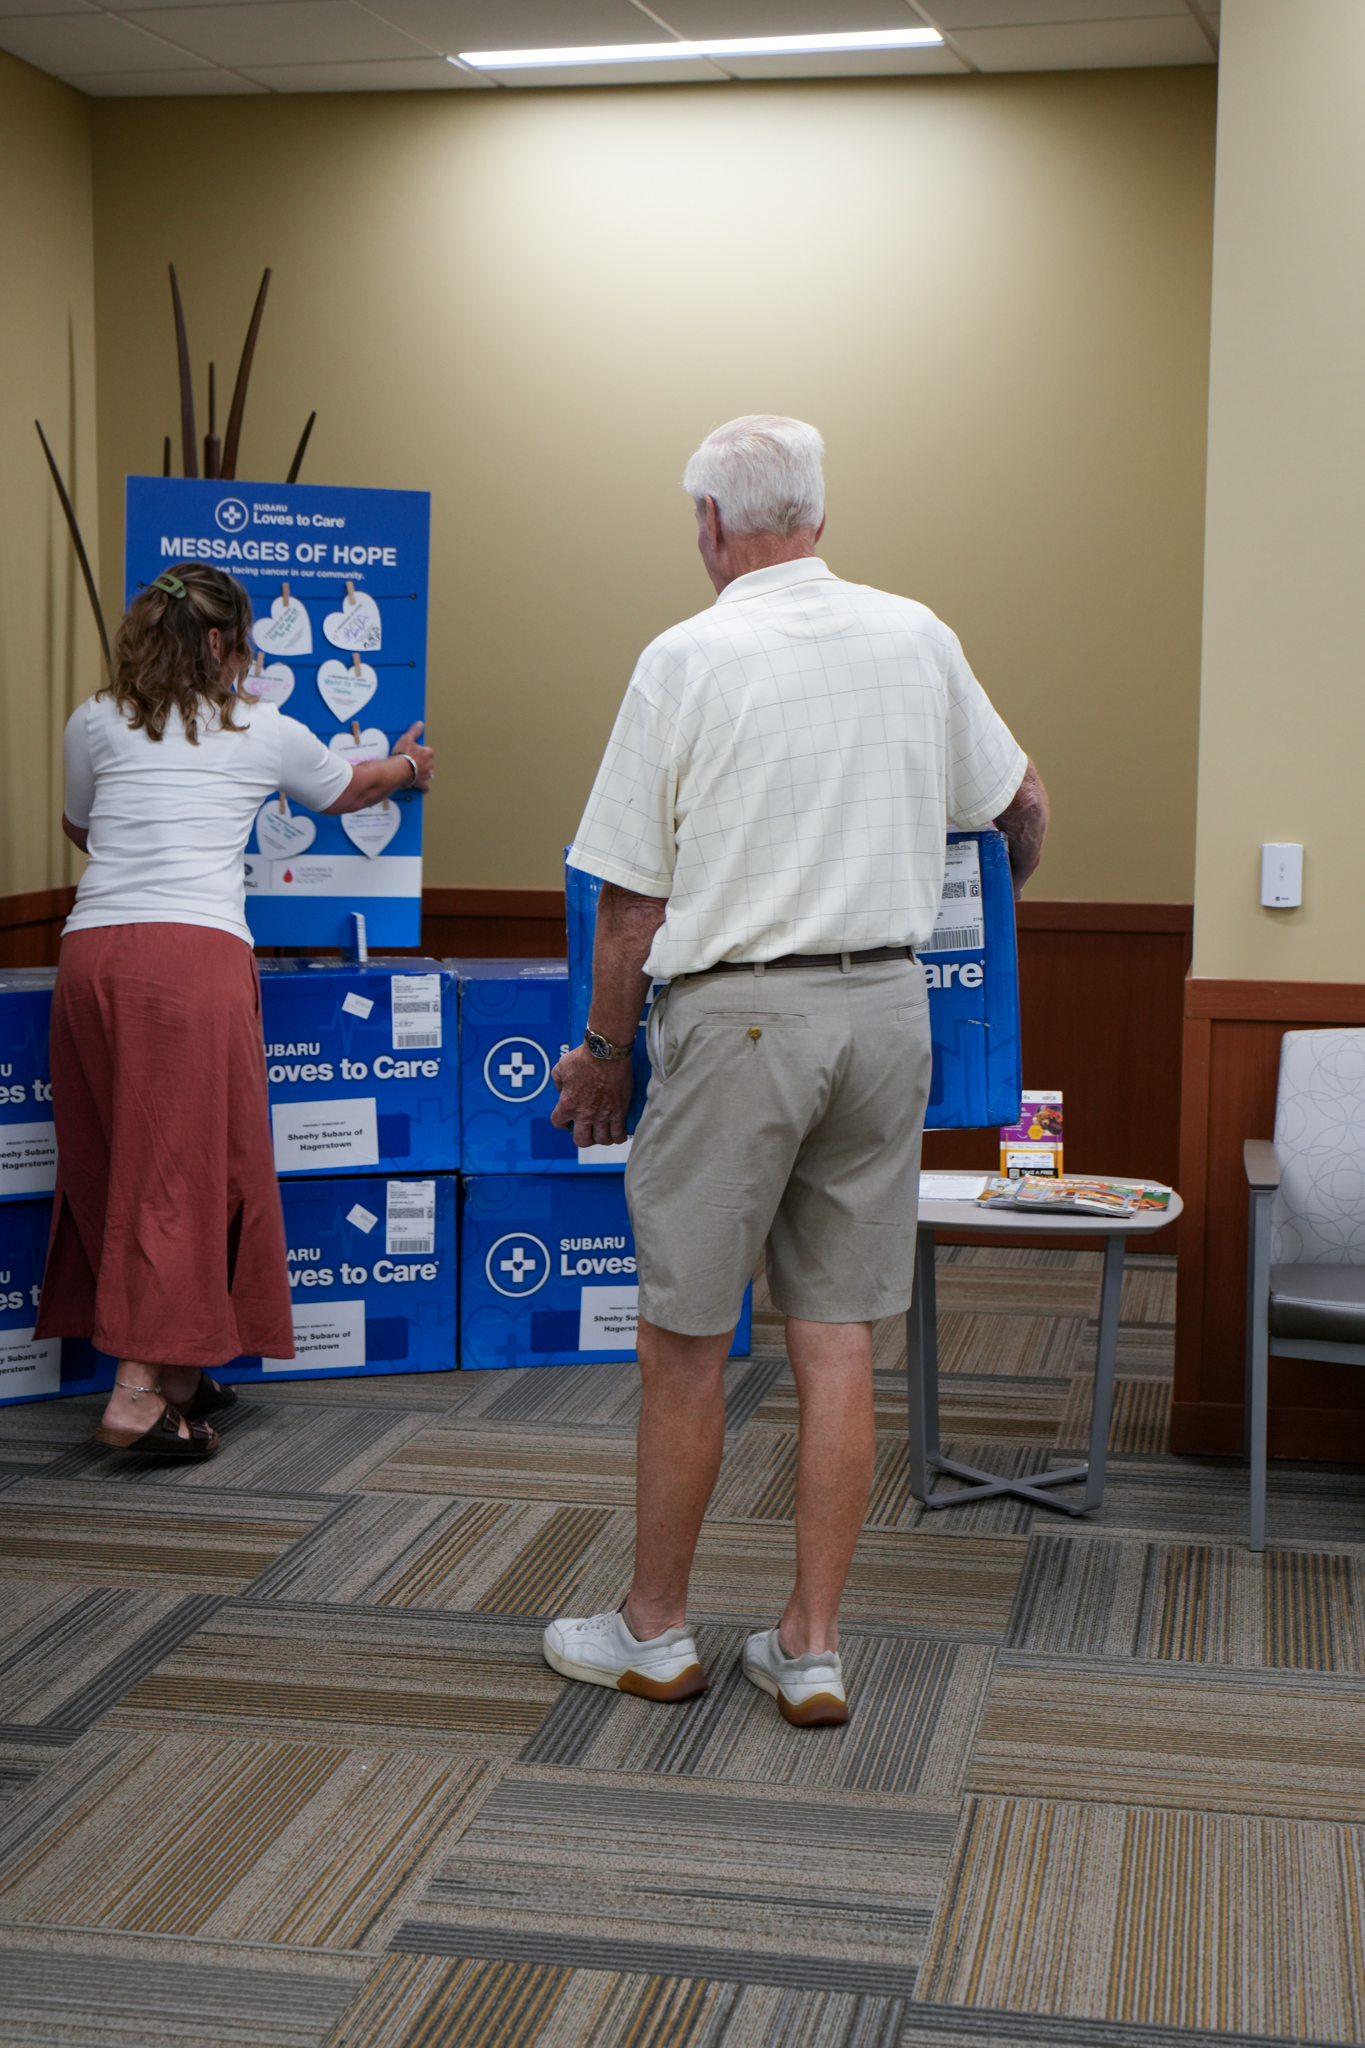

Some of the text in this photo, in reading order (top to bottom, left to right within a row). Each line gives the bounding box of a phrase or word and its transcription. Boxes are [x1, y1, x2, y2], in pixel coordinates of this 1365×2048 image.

[253, 503, 288, 512] SUBARU
[253, 511, 294, 526] Loves
[296, 514, 310, 526] to
[160, 536, 397, 566] MESSAGES OF HOPE
[232, 565, 259, 577] facing
[260, 568, 290, 576] cancer
[291, 568, 299, 576] in
[316, 571, 365, 581] community.
[922, 962, 986, 989] are
[264, 1042, 320, 1057] UBARU
[268, 1063, 334, 1083] oves
[339, 1058, 368, 1080] to
[287, 1132, 319, 1141] Sheehy
[321, 1130, 352, 1139] Subaru
[0, 1147, 56, 1159] eehy Subaru
[300, 1141, 352, 1152] Hagerstown
[2, 1159, 55, 1171] Hagerstown
[559, 1236, 626, 1251] SUBARU
[286, 1248, 321, 1261] ARU
[560, 1254, 637, 1276] Loves
[288, 1268, 334, 1287] ves
[339, 1263, 368, 1285] to
[593, 1315, 623, 1323] Sheehy
[604, 1325, 638, 1333] Hagerst
[294, 1343, 340, 1353] agerstown
[7, 1351, 37, 1362] Subaru
[38, 1351, 48, 1359] of
